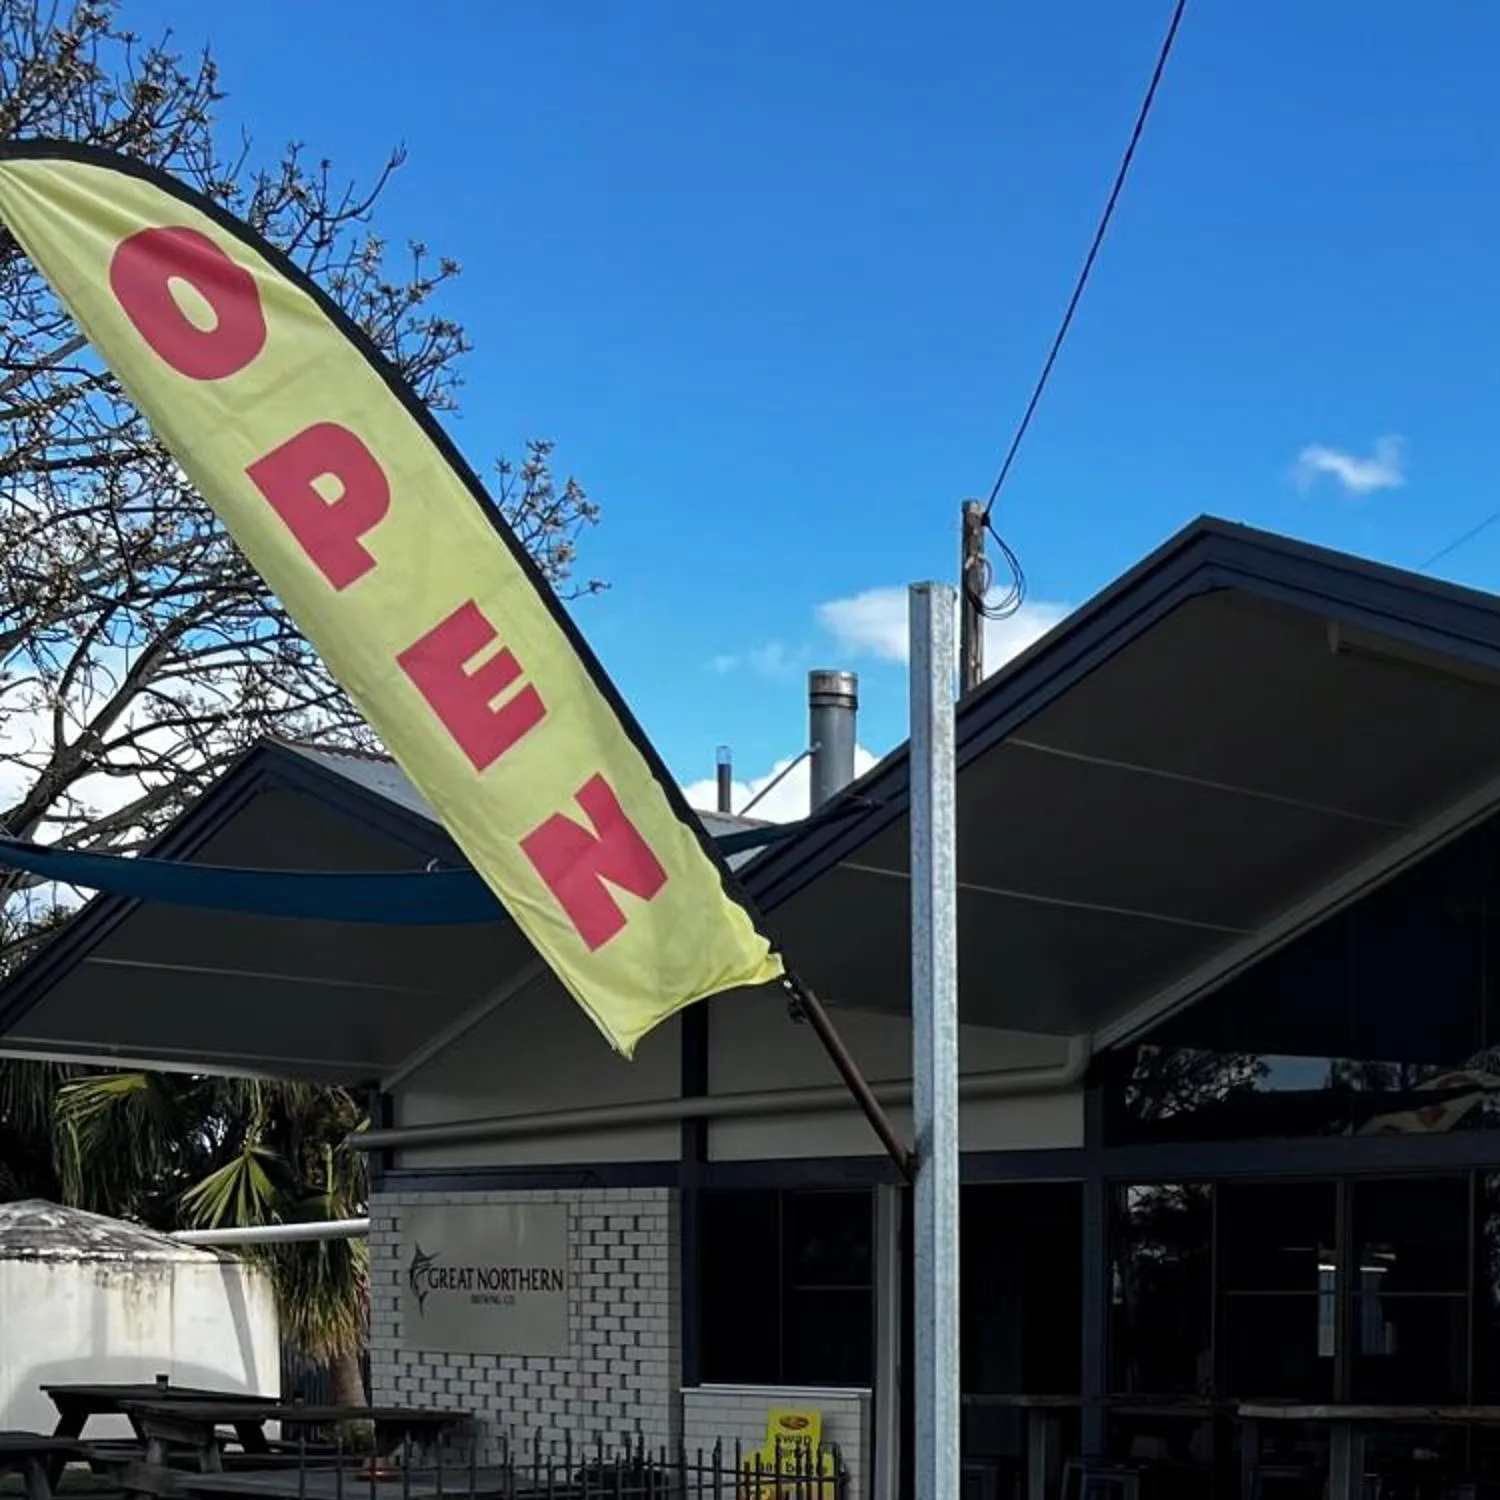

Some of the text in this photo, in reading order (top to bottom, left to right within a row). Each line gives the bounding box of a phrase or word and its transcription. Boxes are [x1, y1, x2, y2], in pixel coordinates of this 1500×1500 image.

[112, 228, 665, 949] OPEN
[427, 1267, 563, 1291] GREAT NORTHERN
